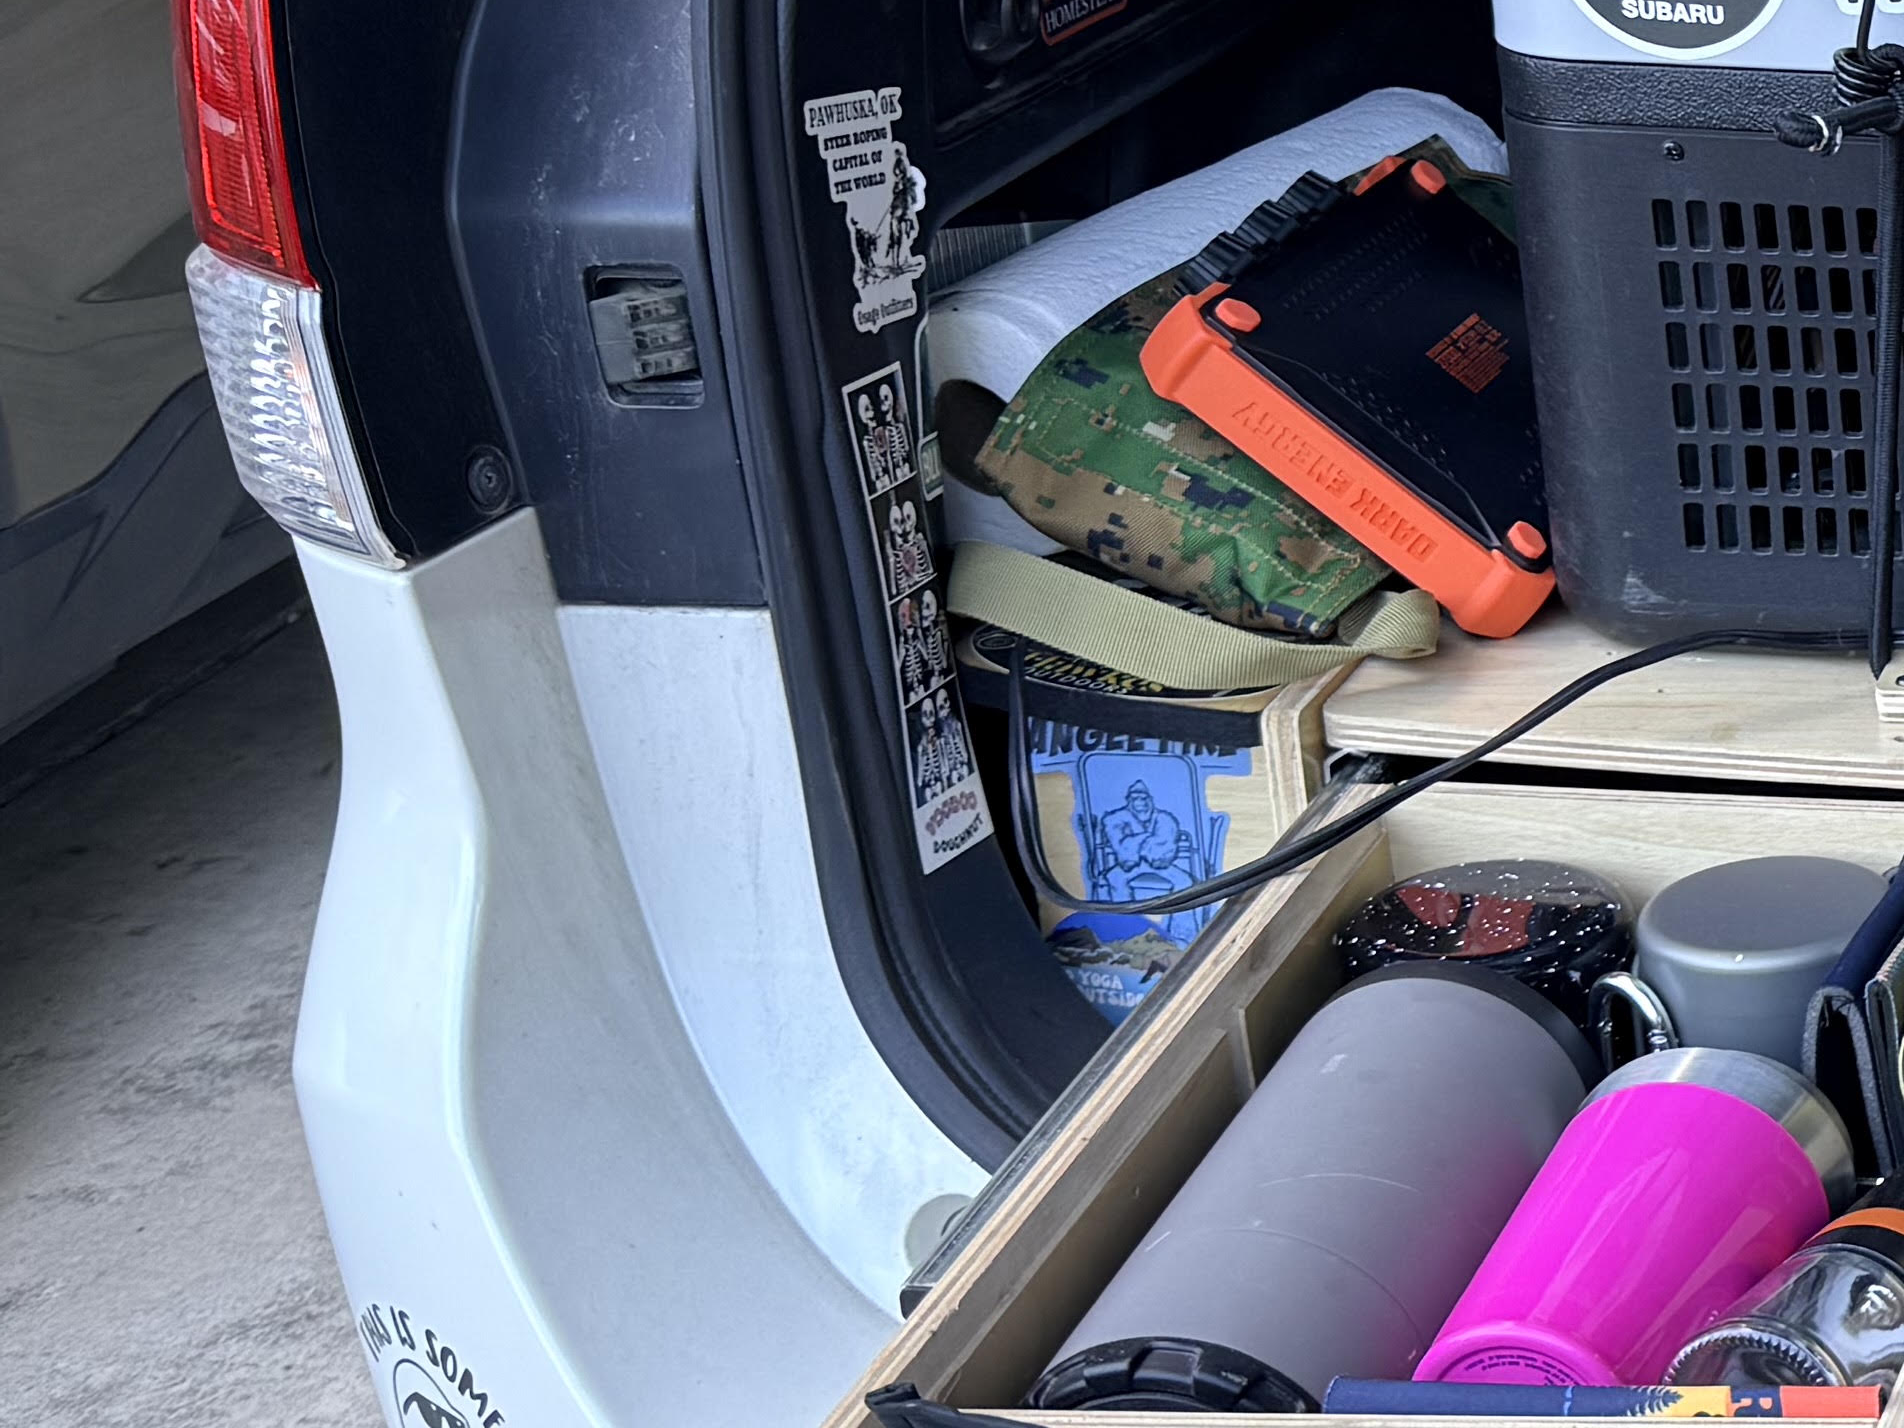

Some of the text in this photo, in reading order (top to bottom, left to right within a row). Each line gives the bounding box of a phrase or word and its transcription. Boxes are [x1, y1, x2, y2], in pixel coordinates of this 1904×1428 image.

[880, 94, 898, 115] OK
[1232, 399, 1440, 563] DARK ENERGY
[389, 1305, 416, 1351] IS
